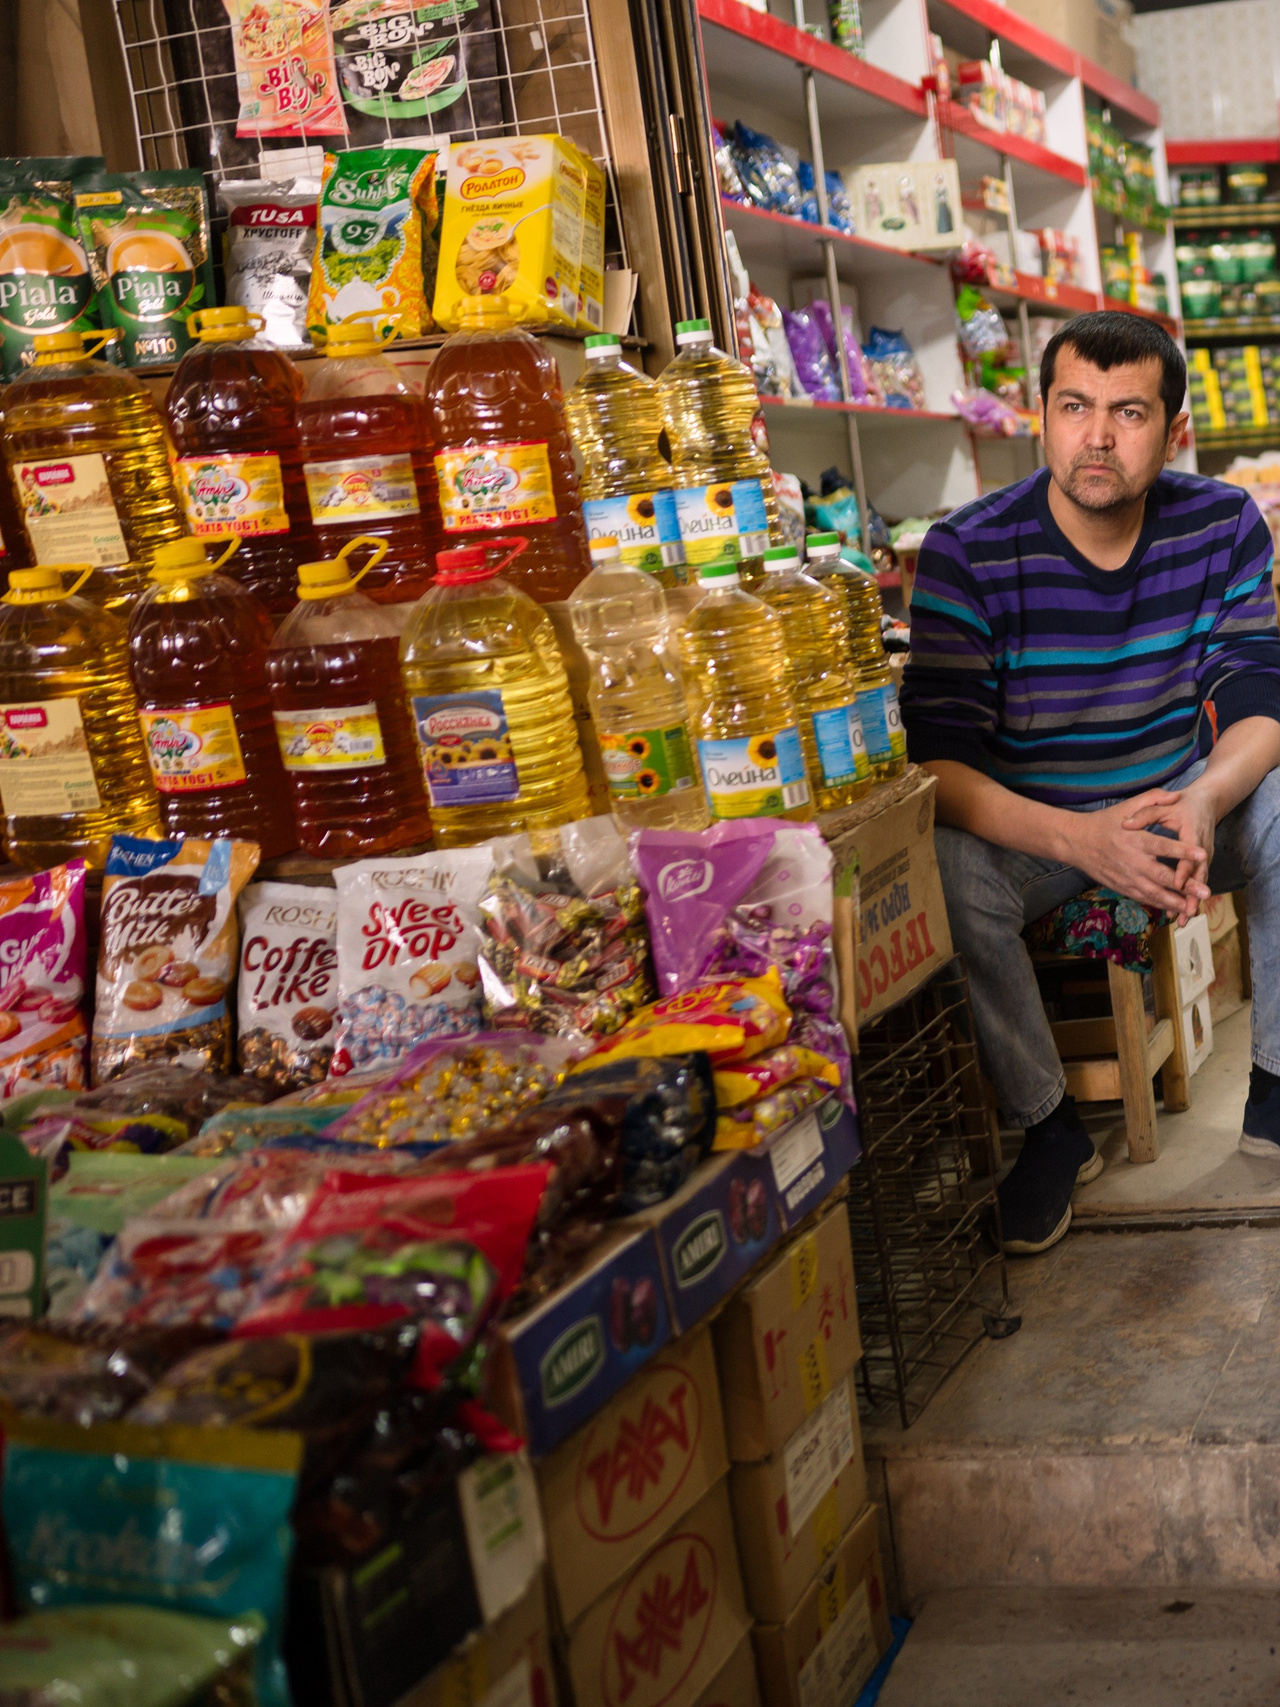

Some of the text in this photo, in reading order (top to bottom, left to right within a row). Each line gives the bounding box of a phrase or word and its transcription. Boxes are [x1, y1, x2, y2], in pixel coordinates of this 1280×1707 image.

[359, 16, 411, 37] BIG
[366, 22, 434, 49] BON
[264, 56, 308, 90] BIG
[352, 51, 387, 71] BIG
[362, 61, 400, 90] BON
[466, 174, 519, 196] РОЛЛТОН
[250, 208, 304, 224] TUSA
[346, 224, 377, 240] 95
[0, 278, 78, 308] Piala
[117, 273, 182, 300] Piala
[109, 887, 202, 924] Butter
[105, 920, 170, 958] Milk
[252, 971, 331, 1011] Like
